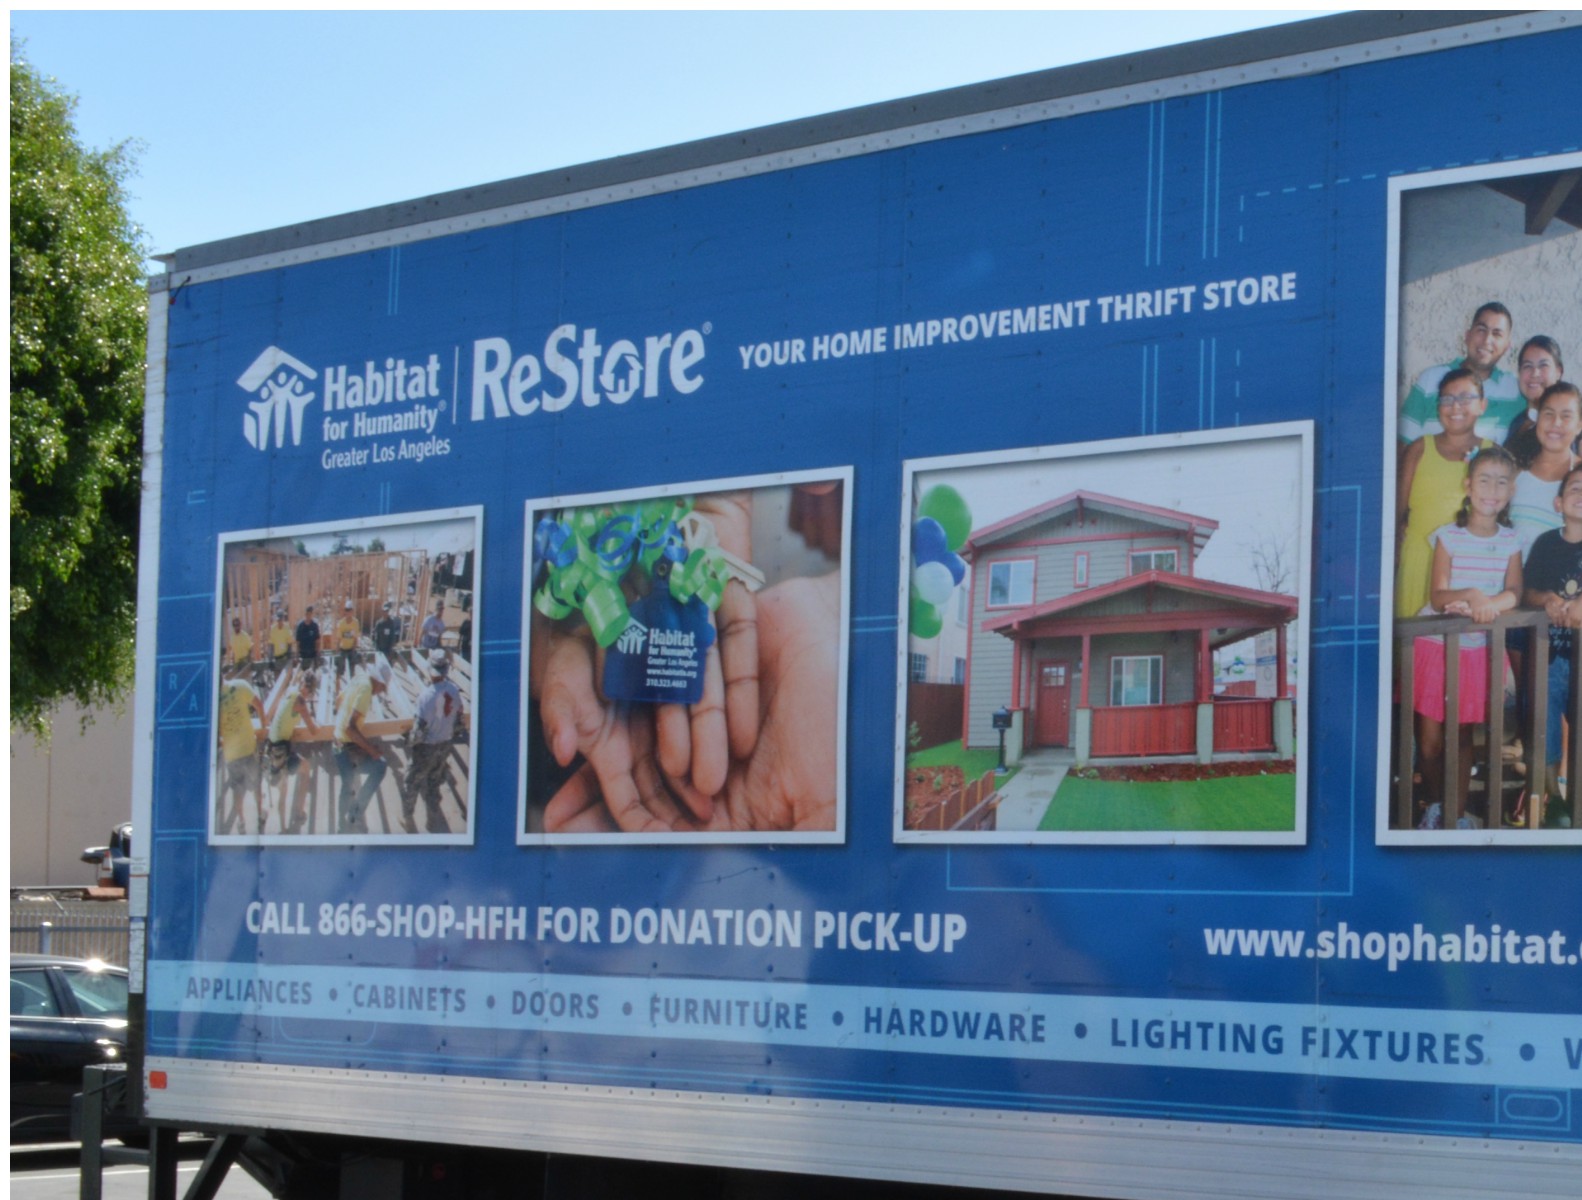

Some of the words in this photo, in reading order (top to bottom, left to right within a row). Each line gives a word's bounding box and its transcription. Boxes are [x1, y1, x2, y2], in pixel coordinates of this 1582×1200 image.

[738, 338, 806, 369] YOUR
[812, 327, 888, 360] HOME
[893, 299, 1090, 350] IMPROVEMENT
[1097, 285, 1196, 324] THRIFT
[1203, 272, 1297, 311] STORE
[323, 352, 441, 412] Habitat
[470, 323, 705, 422] ReStore
[322, 413, 349, 442] for
[353, 405, 439, 438] Humanity
[321, 447, 368, 470] Greater
[373, 443, 396, 463] Los
[398, 436, 451, 465] Angeles
[649, 628, 695, 646] Habitat
[246, 901, 311, 936] CALL
[318, 903, 527, 942] 866-SHOP-HFH
[537, 906, 602, 944] FOR
[610, 907, 802, 948] DONATION
[814, 911, 968, 953] PICK-UP
[186, 976, 313, 1005] APPLIANCES
[353, 983, 467, 1013] CABINETS
[511, 990, 600, 1019] DOORS
[649, 998, 809, 1030] FURNITURE
[863, 1006, 1047, 1043] HARDWARE
[1110, 1017, 1284, 1055] LIGHTING
[1300, 1026, 1486, 1067] FIXTURES
